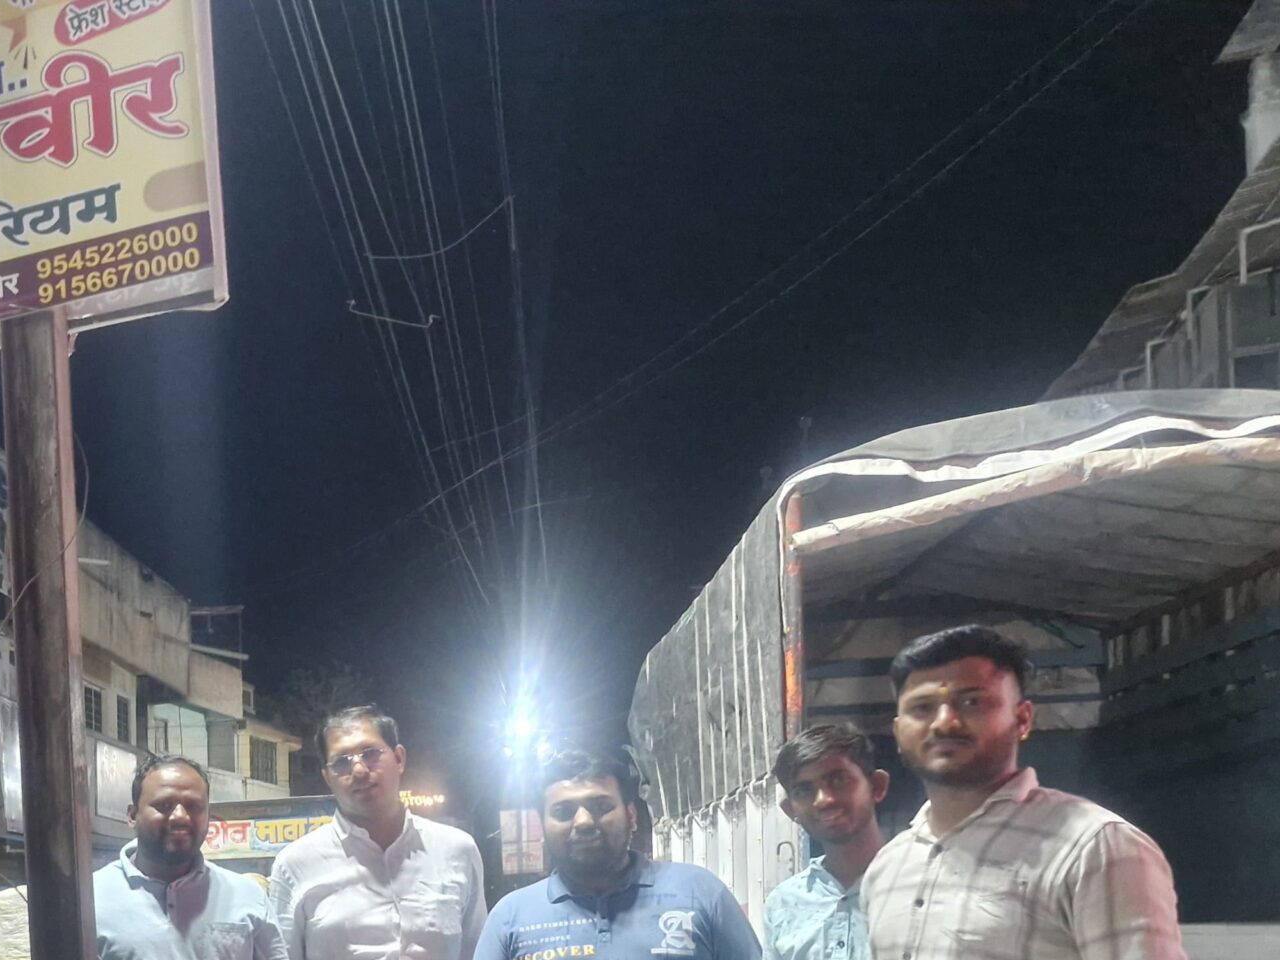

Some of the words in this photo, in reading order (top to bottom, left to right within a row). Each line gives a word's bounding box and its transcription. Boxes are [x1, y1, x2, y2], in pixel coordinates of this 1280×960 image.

[68, 3, 108, 37] फ्रेश
[36, 222, 198, 278] 9545226000
[37, 249, 201, 303] 9156670000
